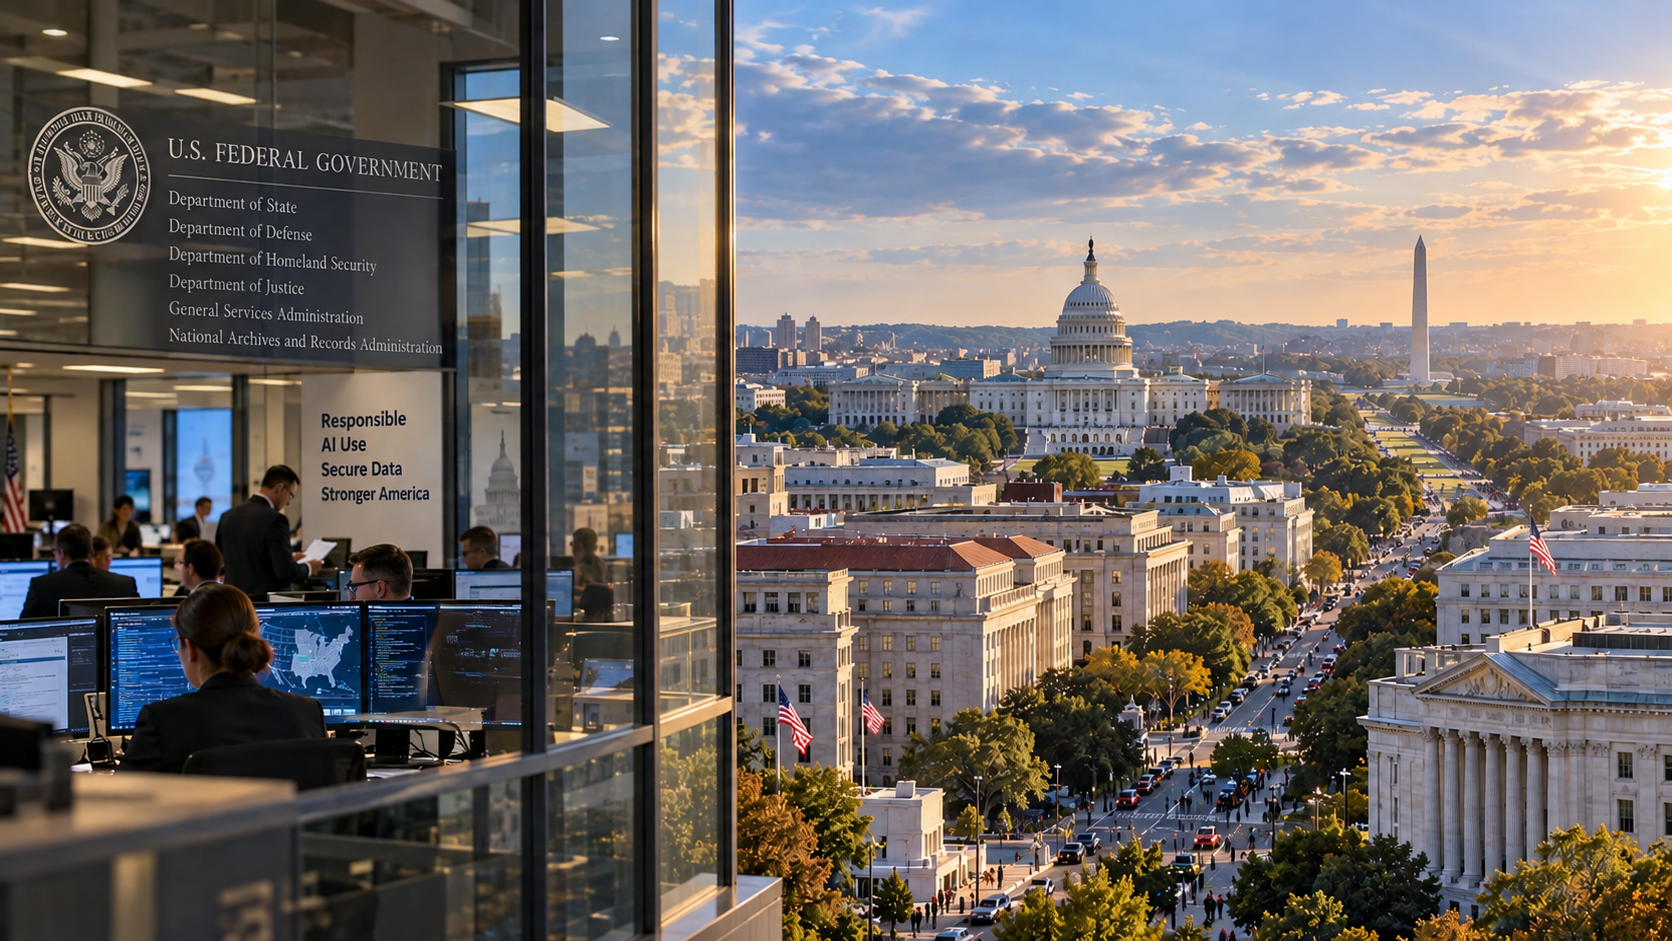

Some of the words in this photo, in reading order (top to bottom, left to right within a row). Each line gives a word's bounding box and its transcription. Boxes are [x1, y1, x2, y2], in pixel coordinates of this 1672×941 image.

[168, 138, 205, 160] U.S.
[216, 143, 308, 169] FEDERAL
[317, 153, 442, 181] GOVERNMENT
[169, 191, 245, 210] Department
[250, 197, 263, 211] of
[267, 198, 297, 213] State
[169, 219, 245, 238] Department
[250, 224, 263, 237] of
[267, 225, 312, 241] Defense
[170, 246, 245, 265] Department
[250, 251, 263, 265] of
[266, 252, 326, 269] Homeland
[331, 256, 376, 276] Security
[170, 274, 245, 293] Department
[250, 279, 263, 292] of
[265, 279, 304, 295] Justice
[169, 301, 218, 317] General
[224, 304, 272, 320] Services
[278, 307, 363, 324] Administration
[170, 328, 223, 343] National
[228, 331, 280, 347] Archives
[285, 334, 306, 347] and
[311, 335, 356, 350] Records
[360, 338, 442, 354] Administration
[321, 410, 406, 431] Responsible
[321, 437, 335, 452] AI
[340, 437, 366, 451] Use
[321, 462, 367, 477] Secure
[371, 461, 402, 476] Data
[321, 487, 376, 504] Stronger
[378, 486, 429, 500] America
